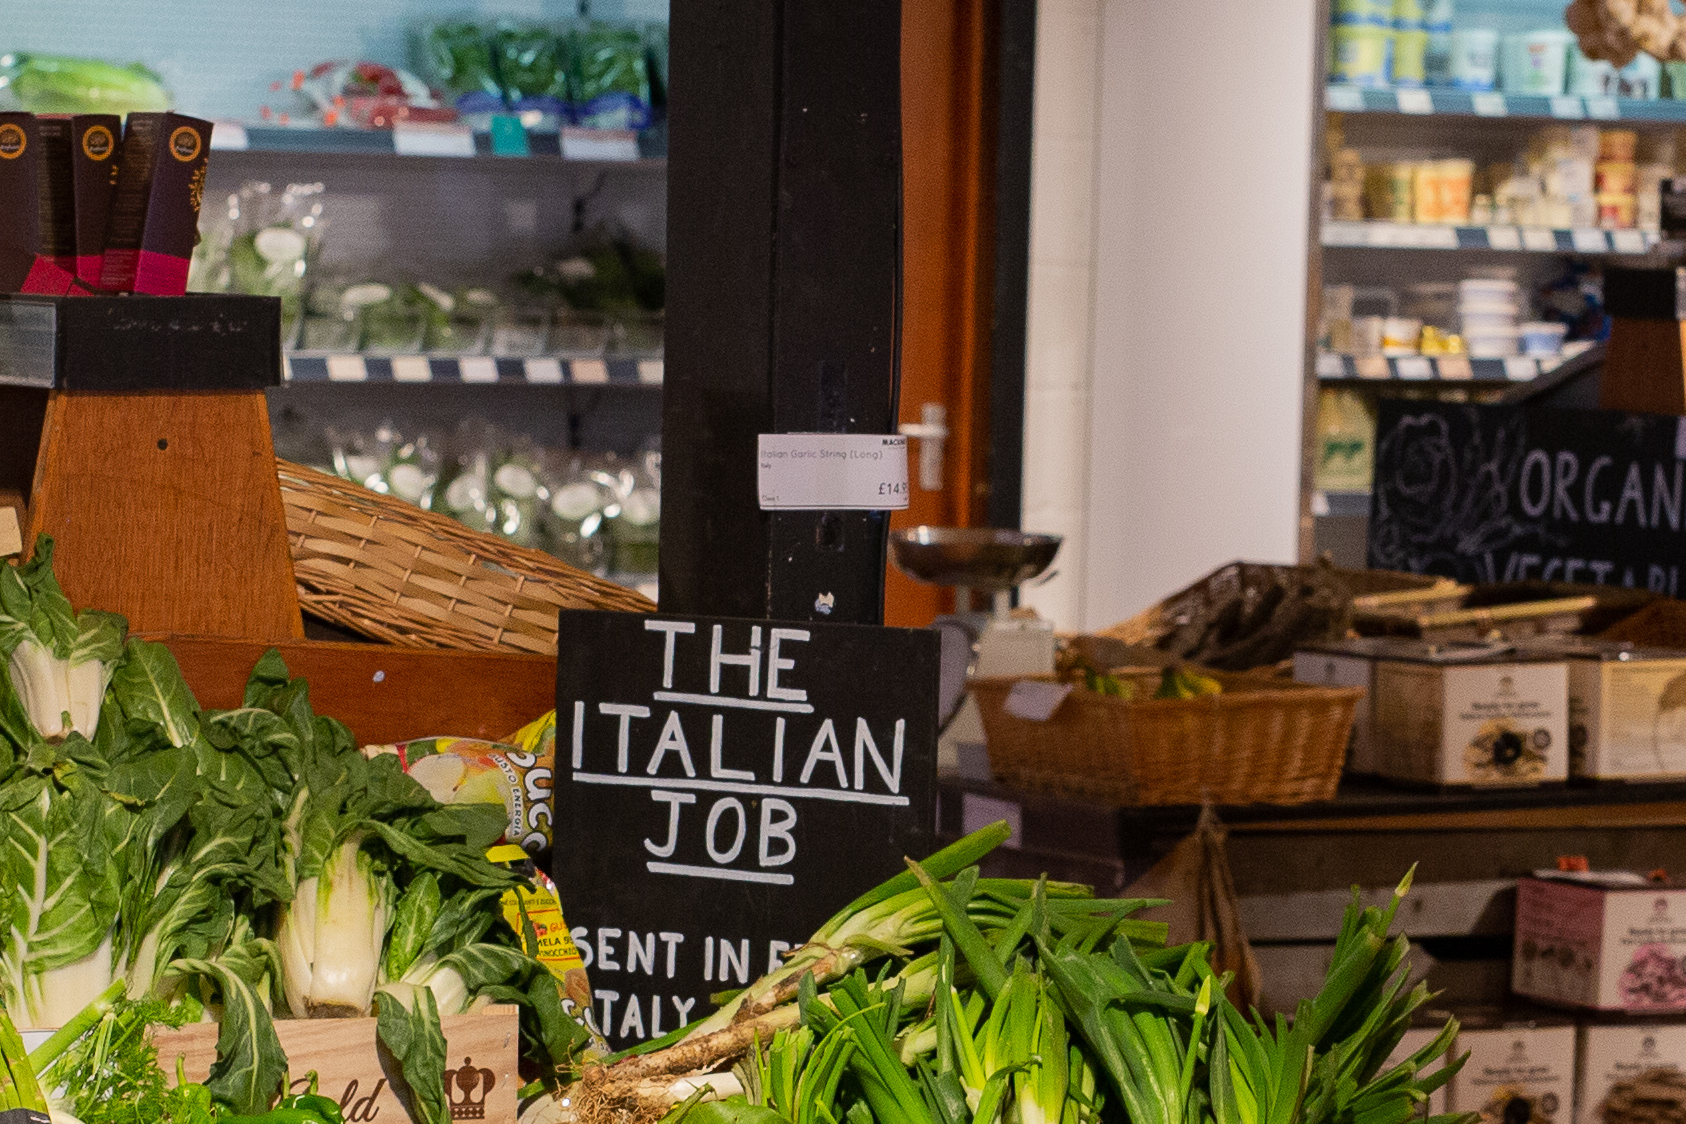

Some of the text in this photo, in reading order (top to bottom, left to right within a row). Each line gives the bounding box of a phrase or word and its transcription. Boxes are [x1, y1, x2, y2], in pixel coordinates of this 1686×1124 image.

[820, 450, 847, 459] String
[850, 450, 883, 459] (Long)
[1519, 449, 1686, 532] ORGAN
[645, 620, 811, 701] THE
[572, 701, 905, 794] ITALIAN
[644, 790, 797, 867] JOB
[570, 926, 684, 979] SENT
[704, 936, 750, 984] IN
[594, 990, 695, 1040] TALY
